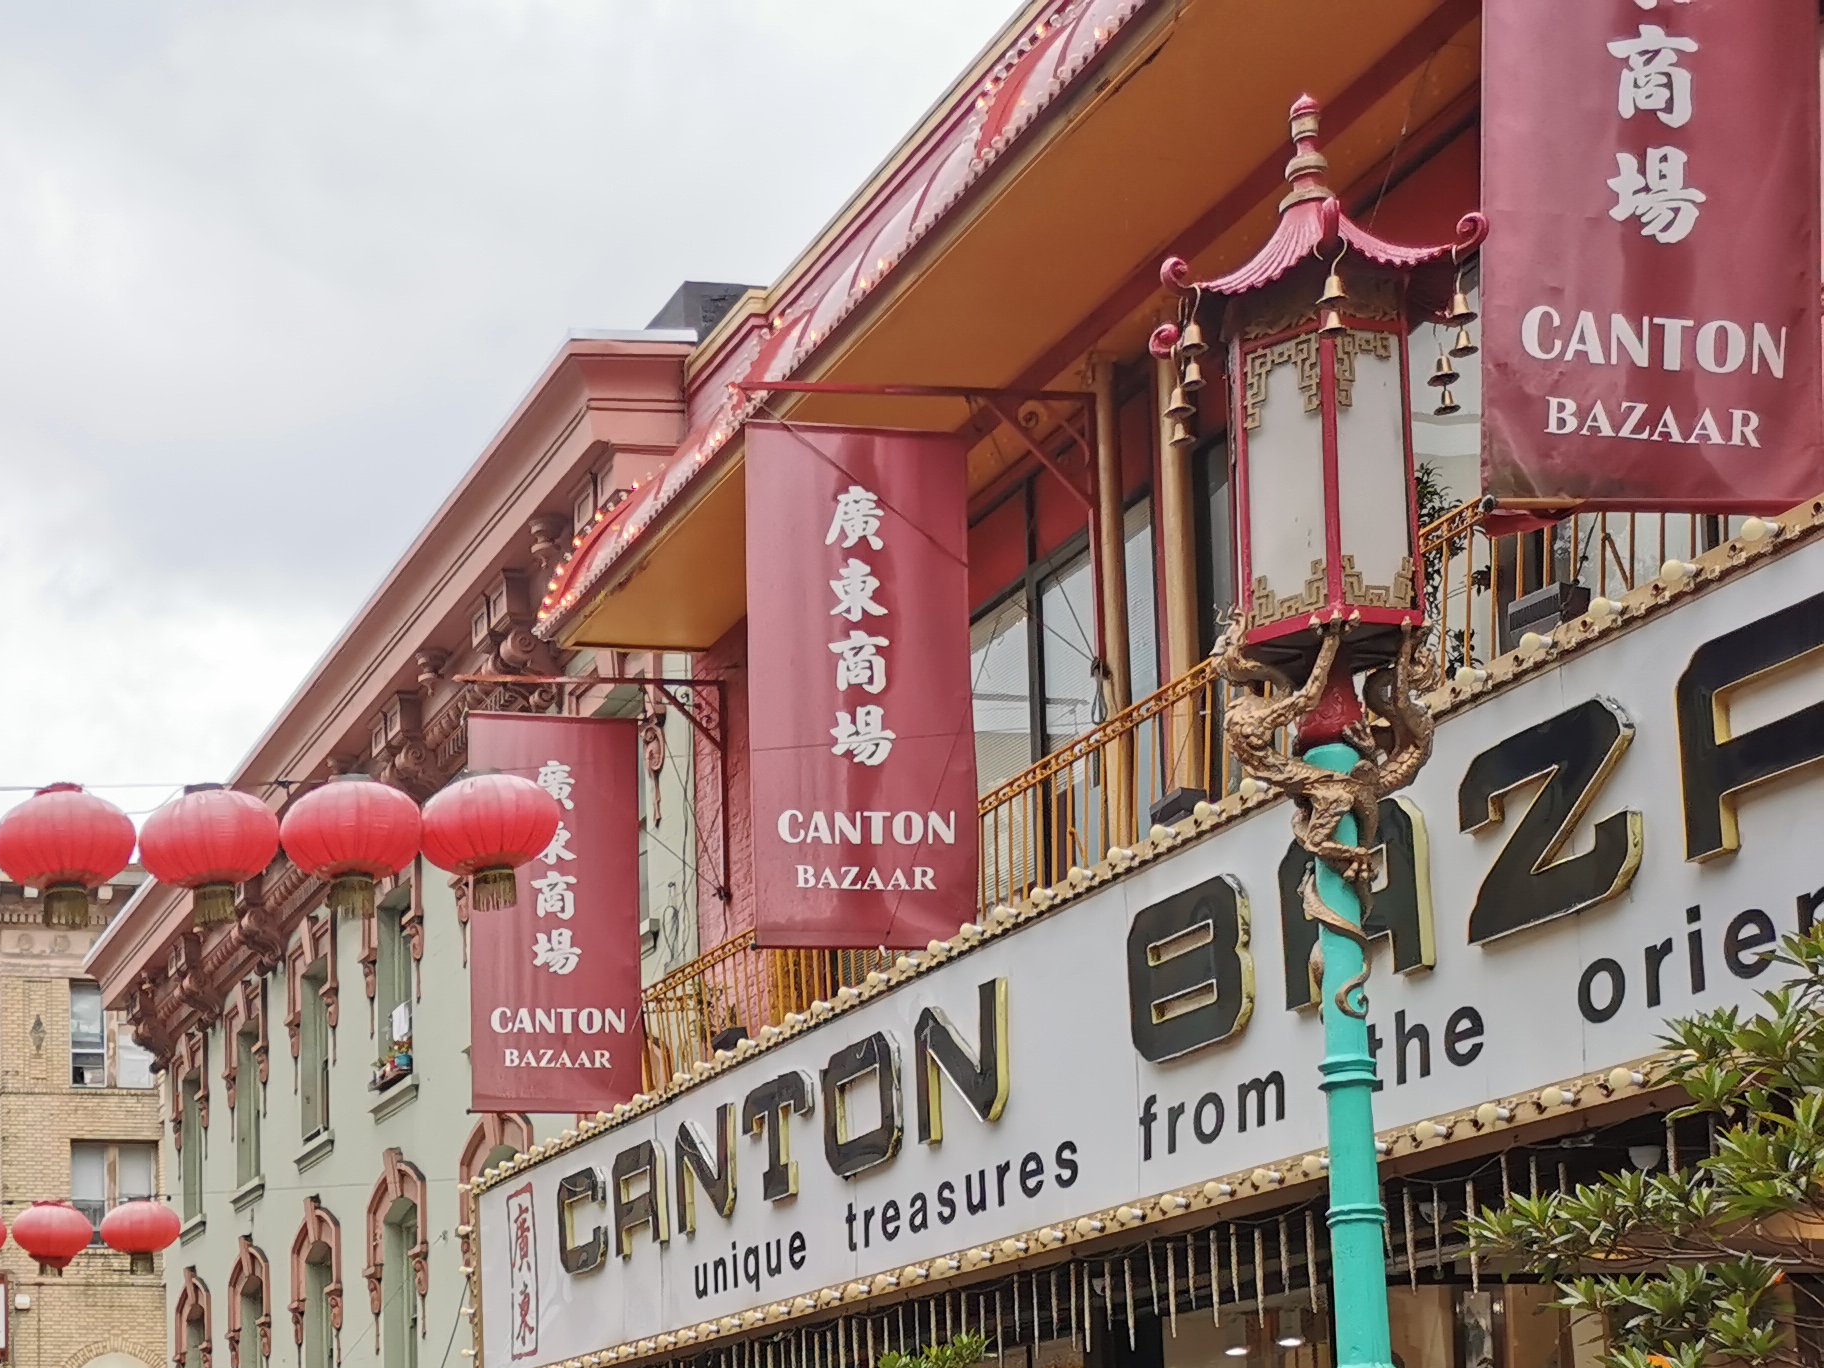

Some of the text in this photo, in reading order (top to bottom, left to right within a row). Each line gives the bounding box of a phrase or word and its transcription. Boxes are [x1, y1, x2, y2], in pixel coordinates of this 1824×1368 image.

[1607, 0, 1706, 243] 商場
[1521, 305, 1787, 379] CANTON
[1544, 396, 1762, 448] BAZAAR
[825, 485, 896, 766] 廣東商場
[777, 809, 956, 846] CANTON
[795, 864, 937, 891] BAZAAR
[489, 1006, 626, 1034] CANTON
[504, 1049, 612, 1069] BAZAAR
[557, 976, 1010, 1275] CANTON
[693, 1230, 808, 1300] unique
[845, 1140, 1079, 1252] treasures
[1139, 1068, 1285, 1161] from
[510, 1201, 536, 1345] 廣東
